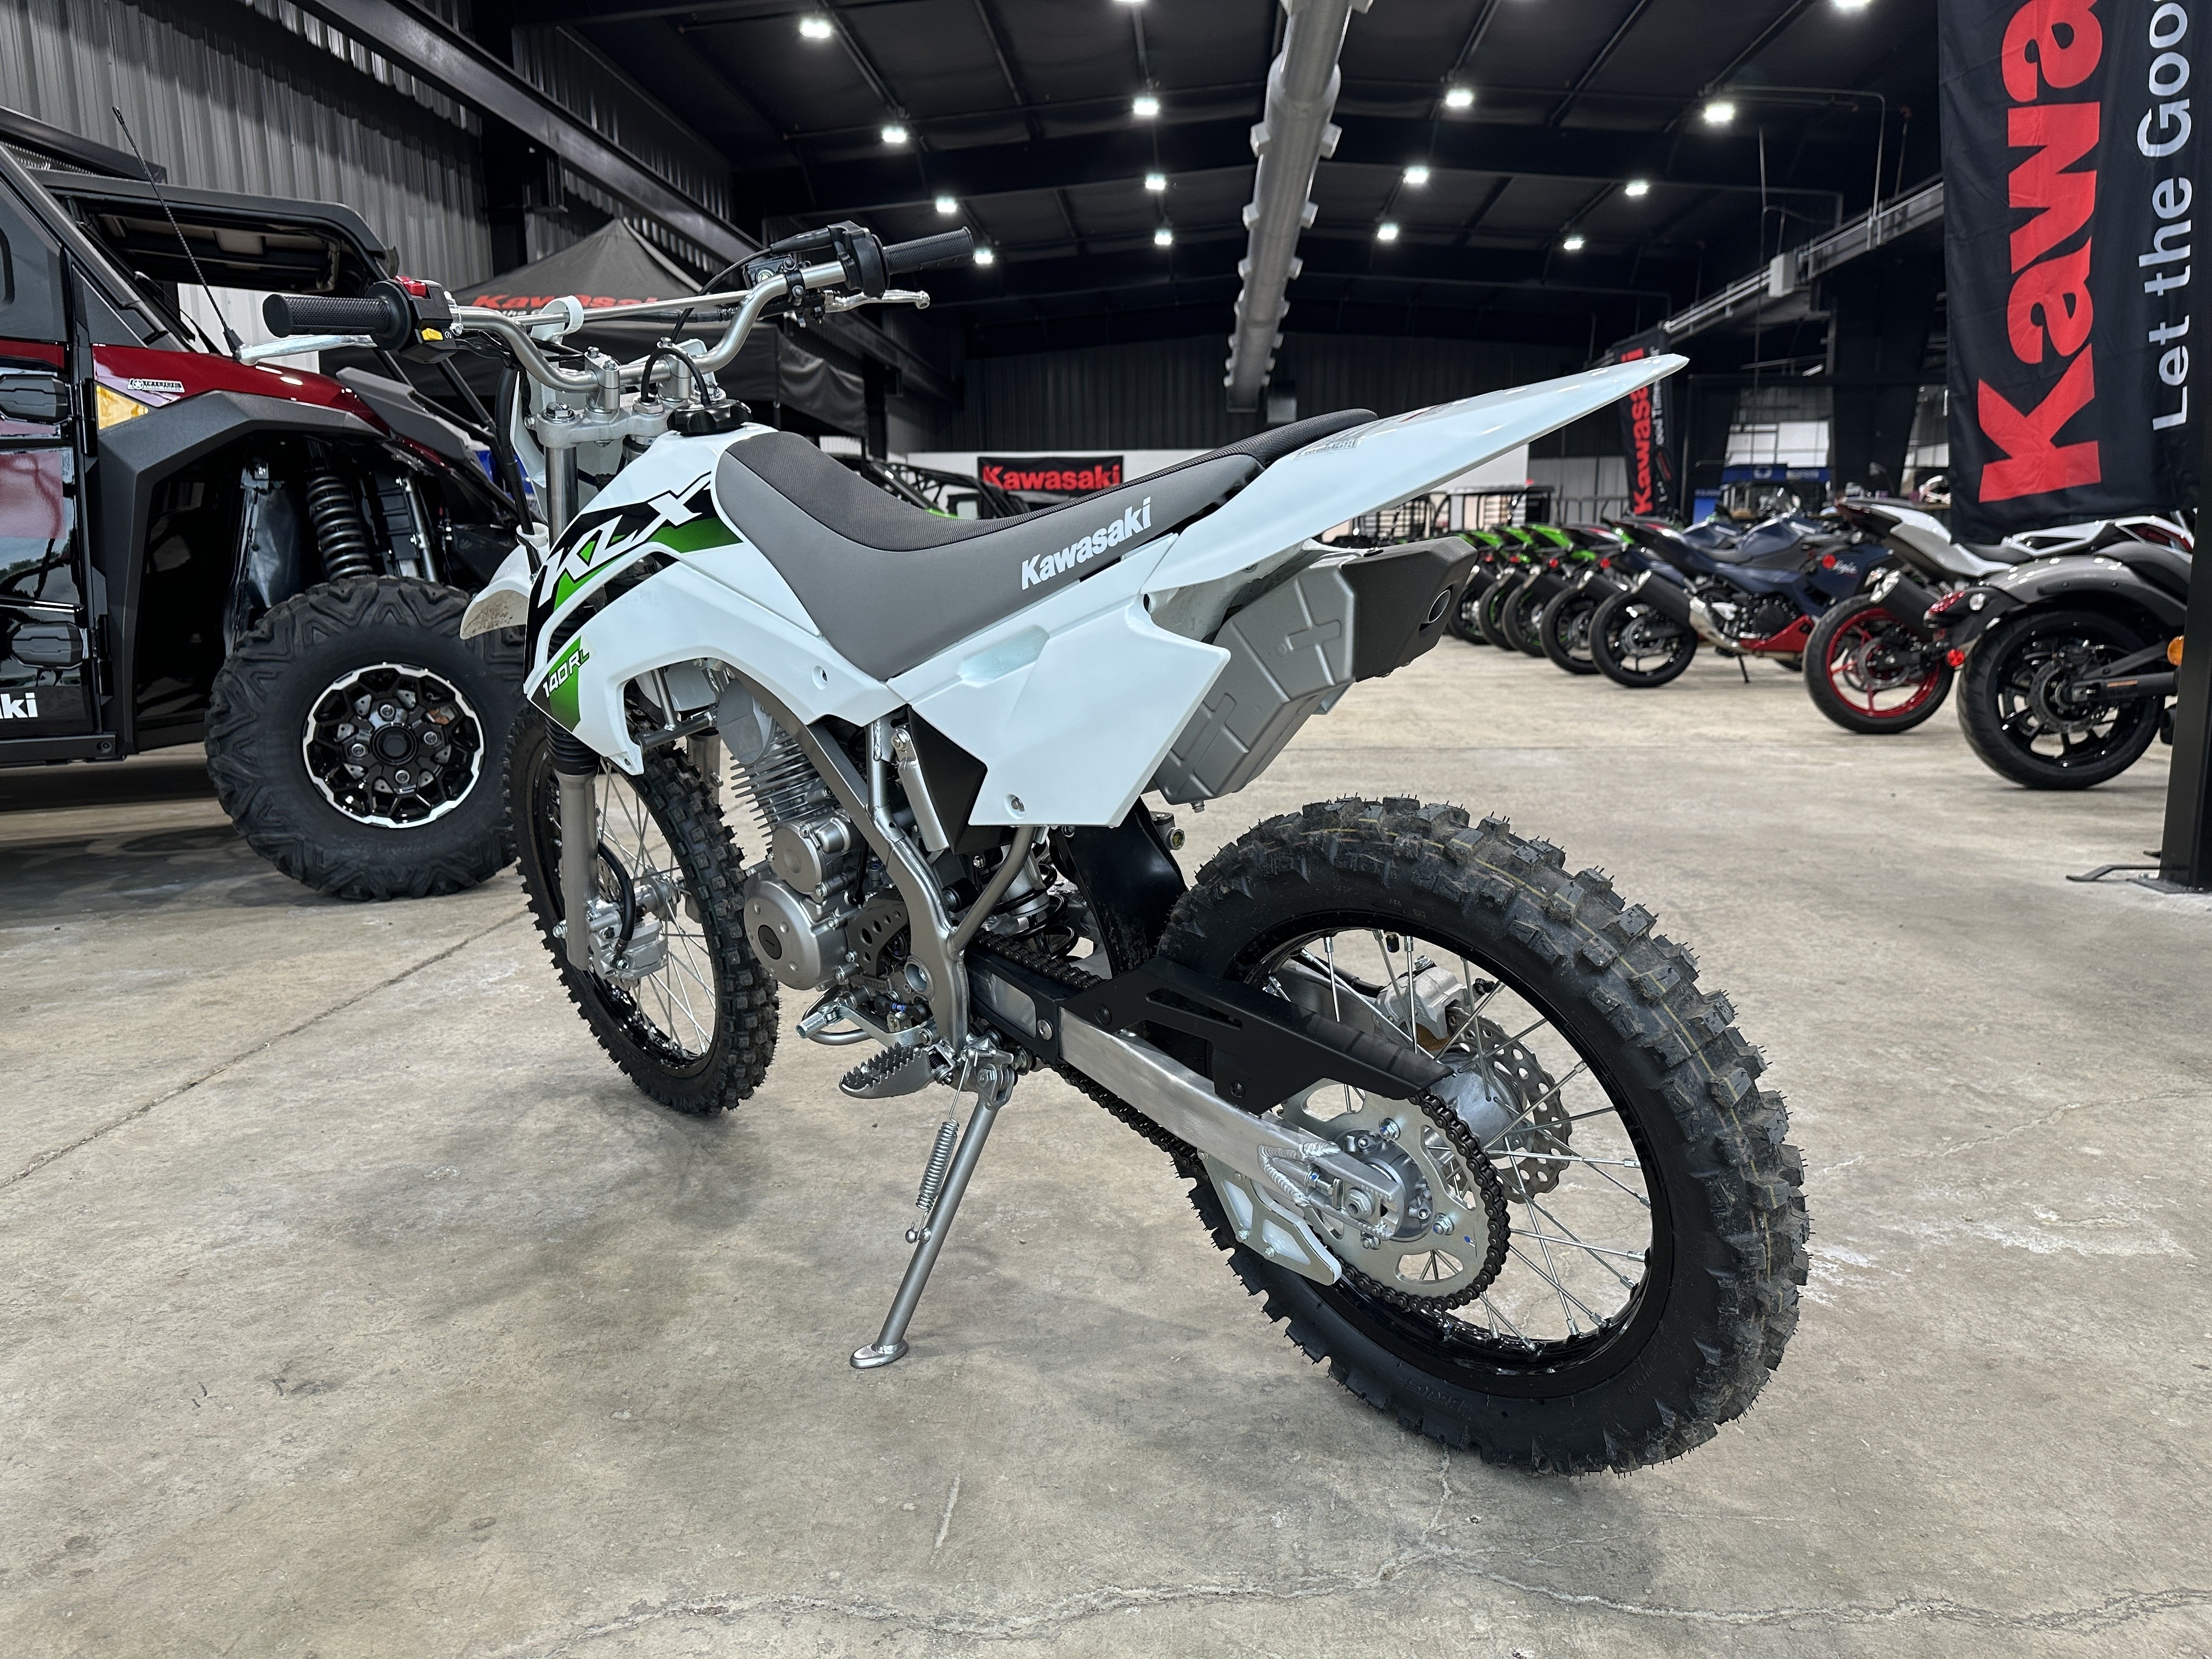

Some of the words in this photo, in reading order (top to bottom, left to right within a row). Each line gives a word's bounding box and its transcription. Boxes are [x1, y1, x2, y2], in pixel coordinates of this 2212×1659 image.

[2137, 0, 2192, 157] Goo
[2139, 177, 2192, 296] the
[2149, 314, 2190, 431] Let
[983, 465, 1121, 491] Kawasaki
[1621, 348, 1653, 516] Kawasai
[538, 478, 712, 608] KLX
[1021, 496, 1152, 591] Kawasaki
[0, 692, 38, 719] ki
[542, 649, 590, 698] 140RL
